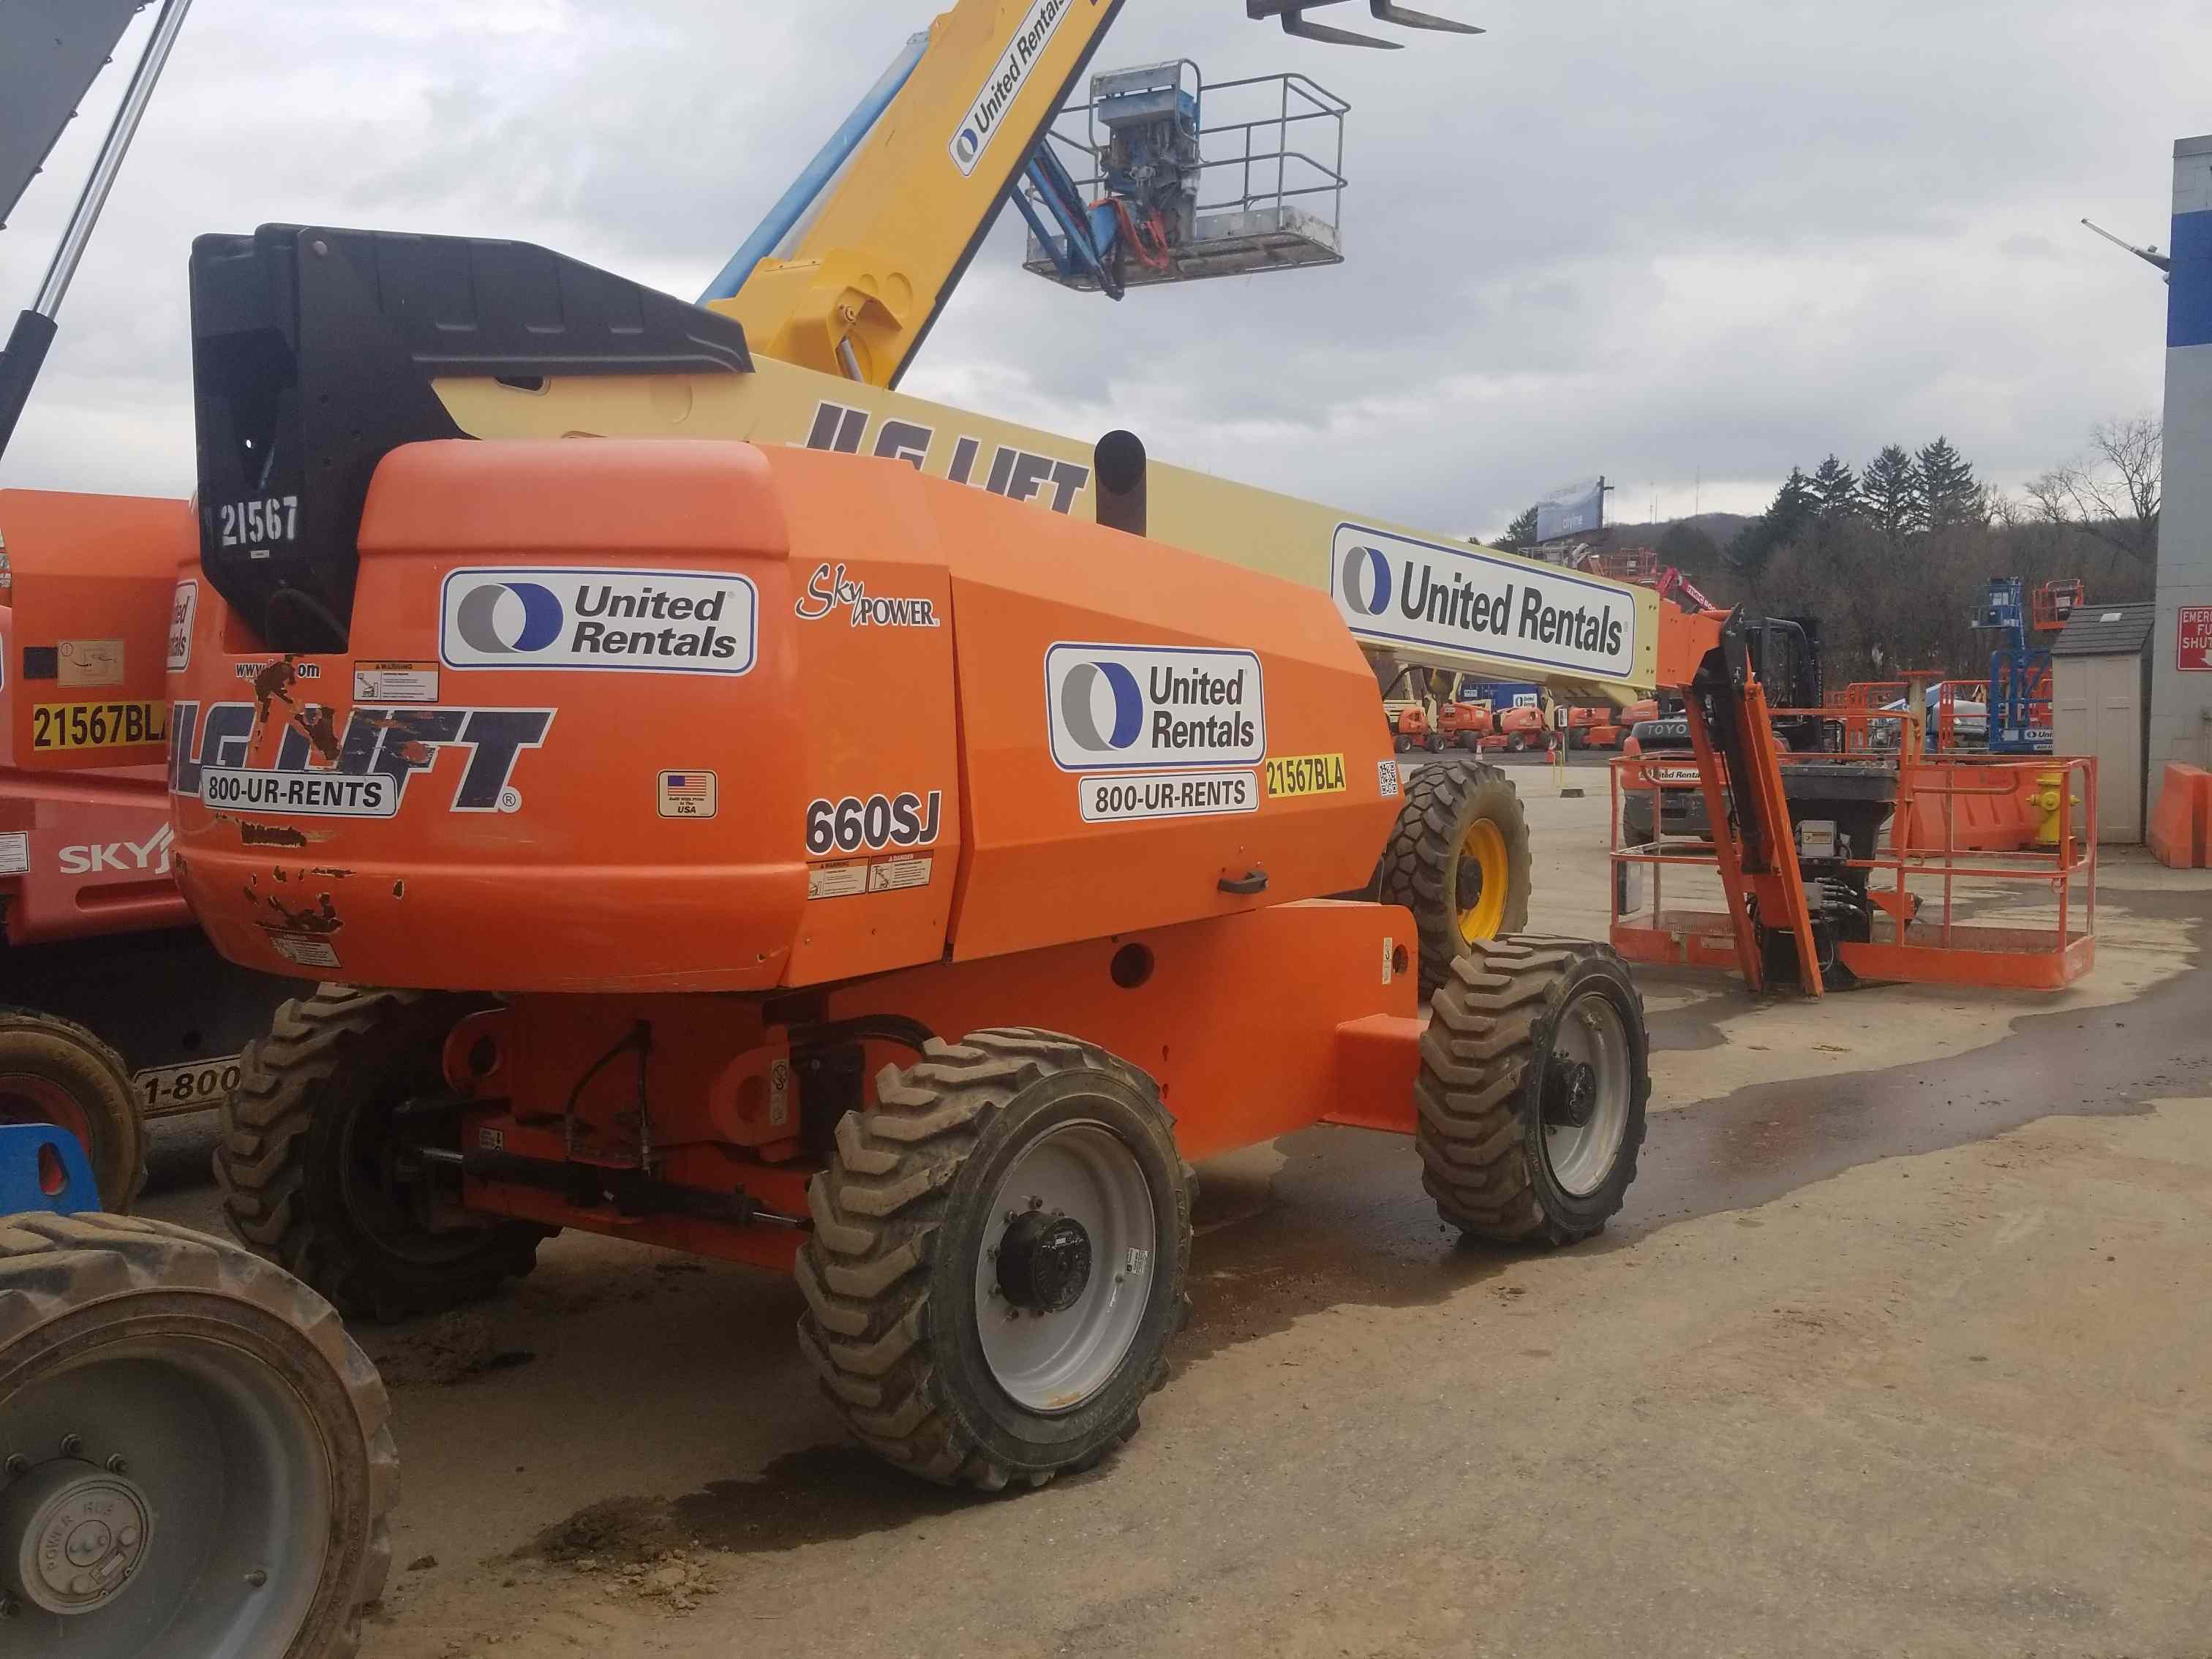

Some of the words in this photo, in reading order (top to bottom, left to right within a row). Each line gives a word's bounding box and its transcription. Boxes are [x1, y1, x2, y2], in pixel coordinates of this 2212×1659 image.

[974, 53, 1020, 134] United
[221, 496, 298, 546] 21567
[575, 585, 726, 622] United
[795, 563, 865, 627] Sky
[860, 598, 935, 626] POWER
[1400, 560, 1514, 636] United
[1519, 586, 1622, 656] Rentals
[571, 622, 737, 659] Rentals
[1148, 666, 1245, 706] United
[1151, 710, 1254, 749] Rentals
[1648, 724, 1686, 734] TOYO
[208, 776, 383, 808] 800-UR-RENTS
[1266, 756, 1346, 795] 21567BLA
[677, 805, 696, 813] USA
[1095, 780, 1246, 813] 800-UR-RENTS
[805, 790, 942, 854] 660SJ
